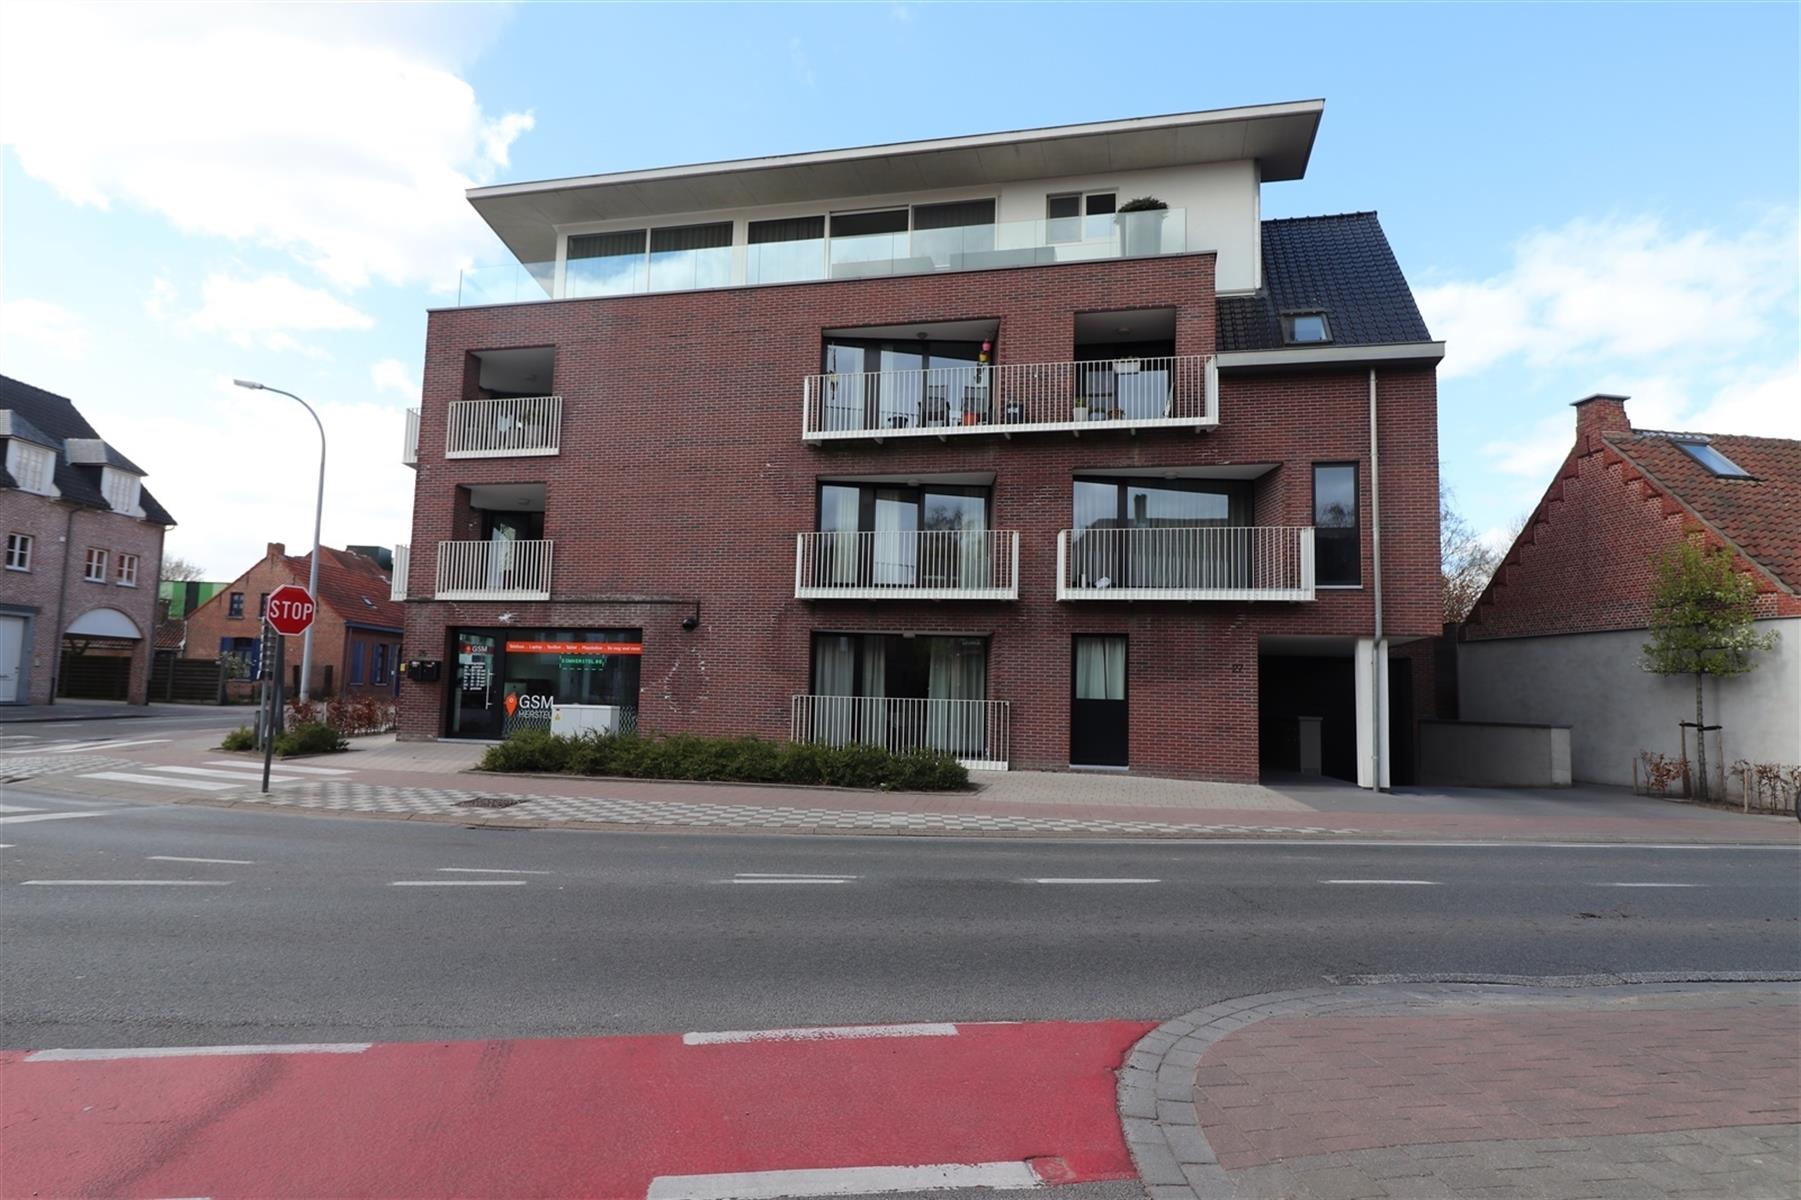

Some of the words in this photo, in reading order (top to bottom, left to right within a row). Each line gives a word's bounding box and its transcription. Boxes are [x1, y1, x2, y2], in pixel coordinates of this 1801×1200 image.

[270, 600, 313, 620] STOP
[472, 645, 488, 653] GSM
[519, 694, 554, 709] GSM
